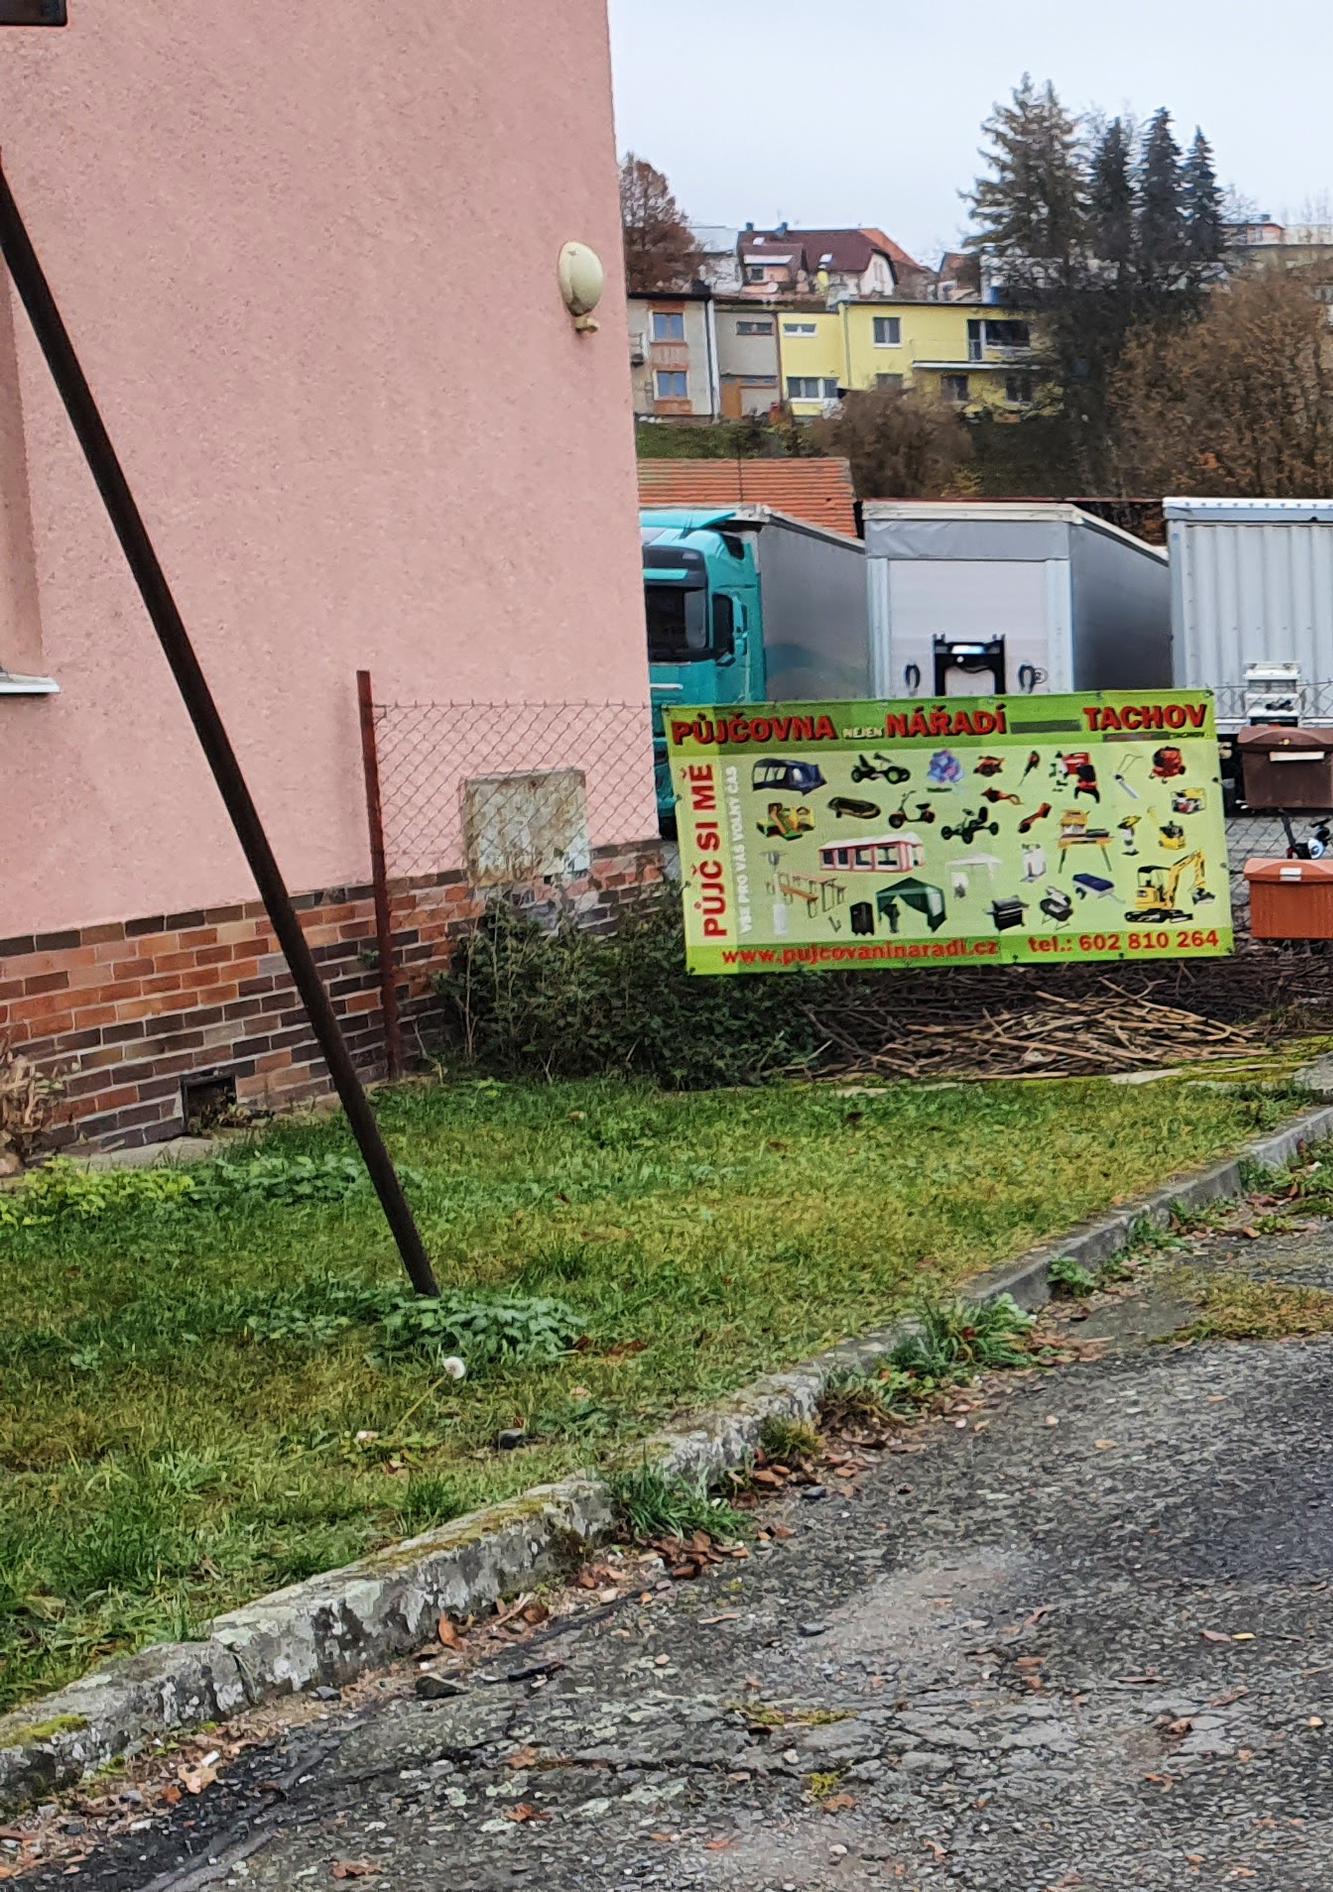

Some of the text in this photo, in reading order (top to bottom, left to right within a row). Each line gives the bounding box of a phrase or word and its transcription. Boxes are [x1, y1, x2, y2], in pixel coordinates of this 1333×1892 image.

[671, 711, 838, 745] PŮJČOVNA
[885, 703, 1008, 739] NÁŘADÍ
[1083, 703, 1208, 731] TACHOV
[680, 764, 728, 937] PŮJČ SI MĚ
[1078, 934, 1120, 951] 602
[1127, 932, 1169, 950] 810
[1175, 930, 1219, 948] 264
